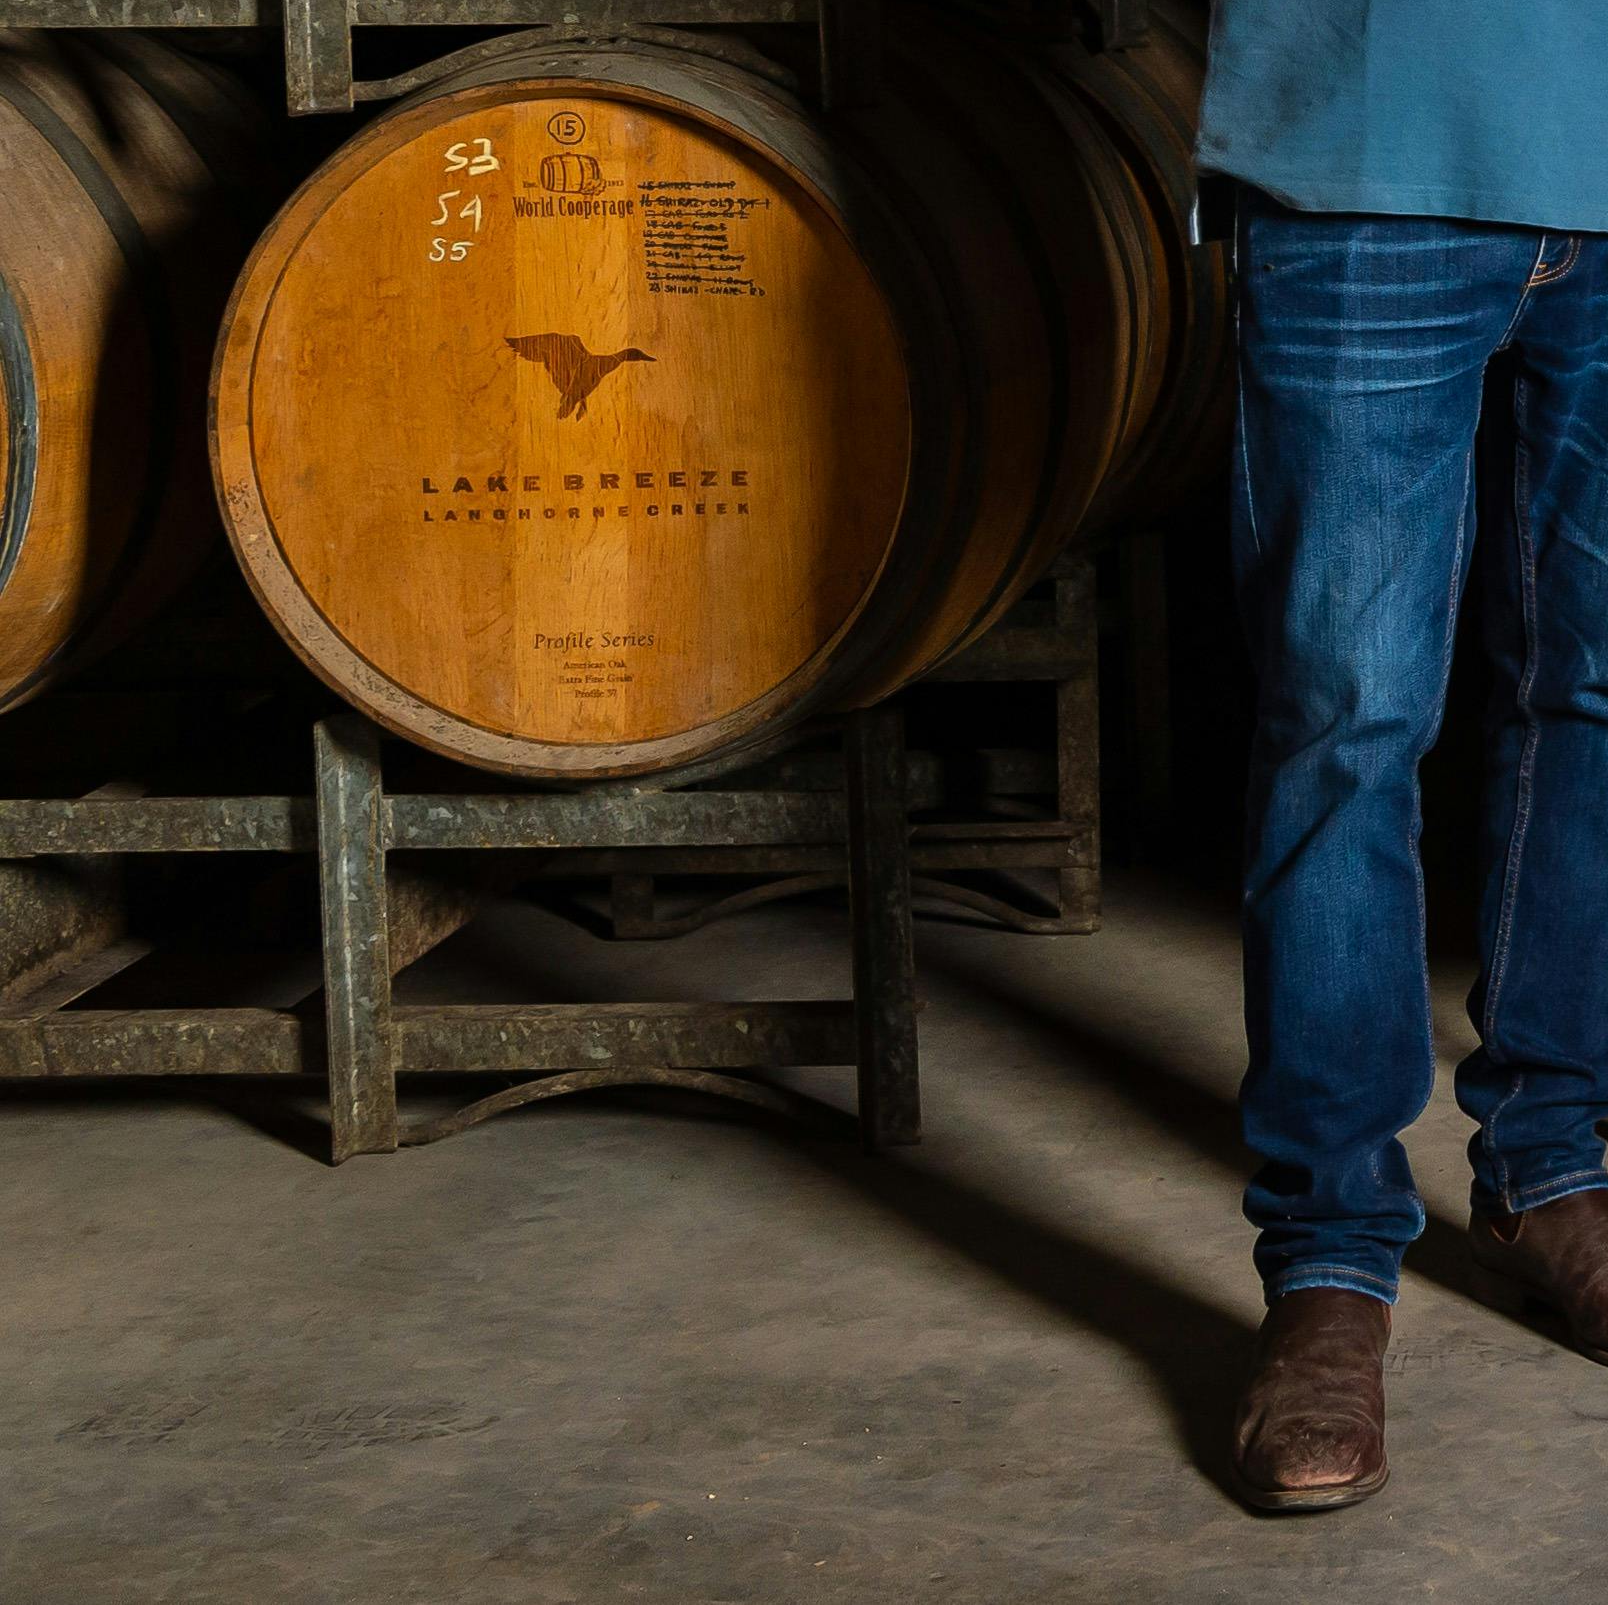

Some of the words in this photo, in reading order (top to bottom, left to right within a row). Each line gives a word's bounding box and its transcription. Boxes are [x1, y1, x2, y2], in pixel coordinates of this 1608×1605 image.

[556, 119, 577, 135] 15
[431, 191, 481, 232] S4
[513, 196, 554, 217] World
[559, 196, 634, 219] Cooperage
[430, 239, 473, 262] S5
[422, 476, 541, 493] LAKE
[564, 471, 748, 491] BREEZE
[424, 506, 629, 522] LANGHORNE
[647, 503, 749, 516] CREEK
[534, 633, 594, 654] Profile
[601, 632, 654, 649] Series
